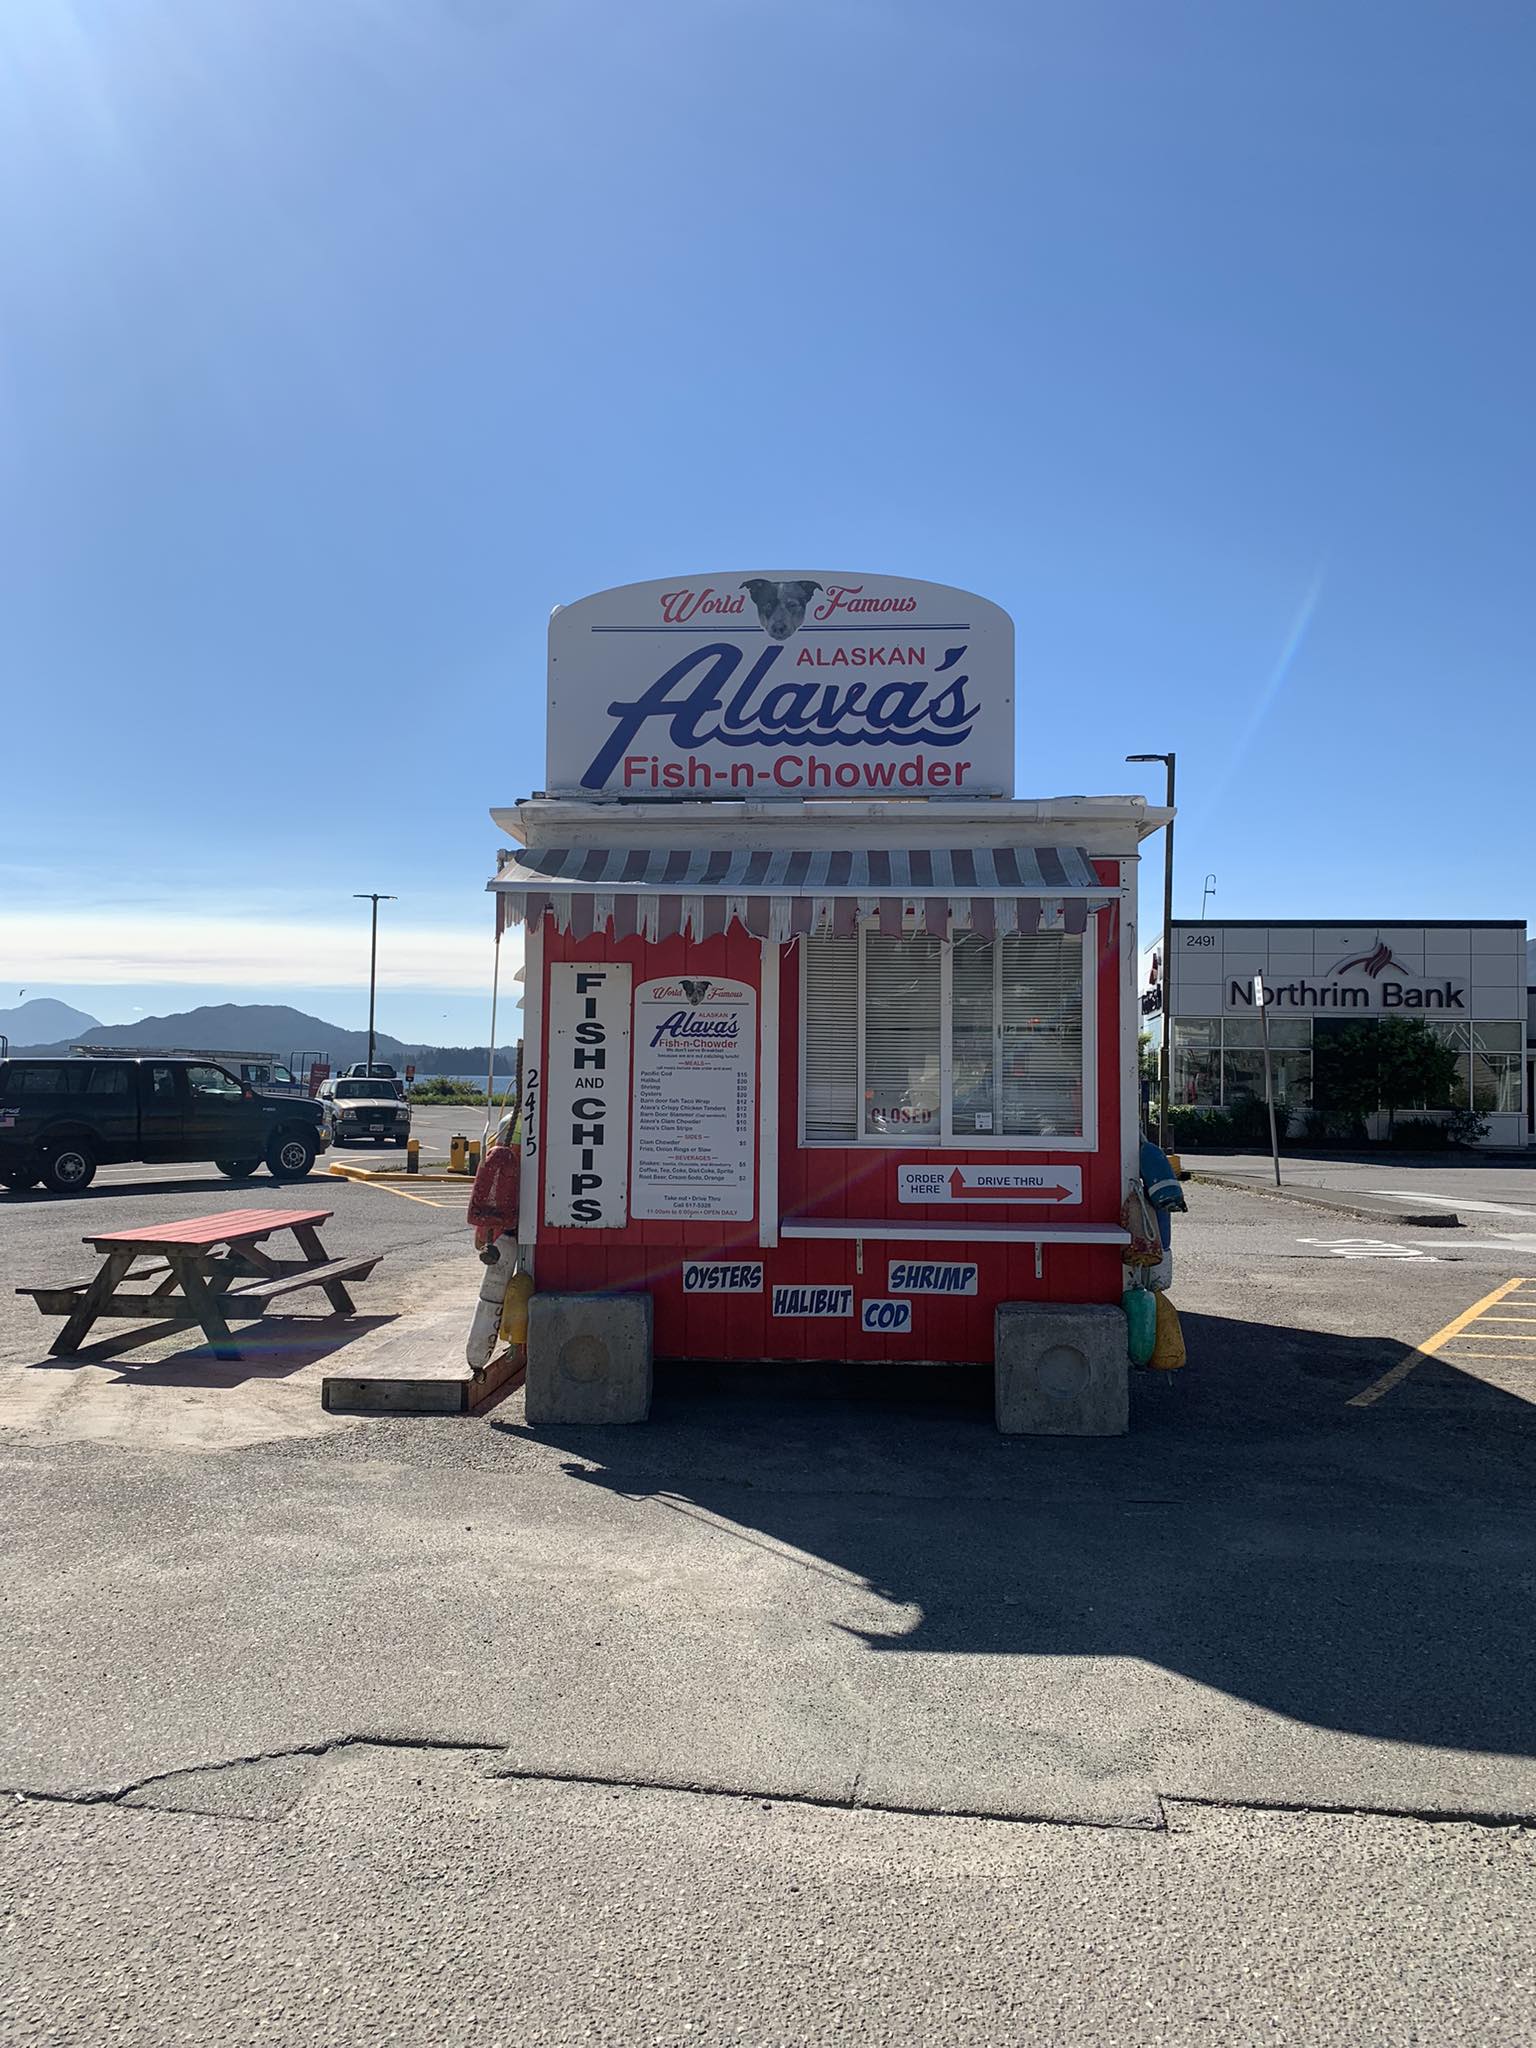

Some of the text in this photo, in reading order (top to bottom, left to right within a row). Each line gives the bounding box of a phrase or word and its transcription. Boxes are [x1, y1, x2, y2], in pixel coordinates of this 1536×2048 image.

[659, 585, 916, 623] World Famous
[796, 647, 925, 666] ALASKAN
[579, 642, 981, 789] Alava's
[623, 755, 971, 788] Fish-n-Chowder
[1186, 936, 1215, 947] 2491
[653, 987, 742, 1000] World Famous
[1231, 981, 1369, 1007] Northrim
[1383, 982, 1465, 1008] Bank
[649, 1011, 740, 1047] Alava's
[659, 1039, 738, 1048] Fish-n-Chowder
[570, 973, 606, 1221] FISH AND CHIPS
[524, 1068, 539, 1157] 2475
[871, 1107, 932, 1124] CLOSED
[906, 1174, 1044, 1186] ORDER DRIVE THRU
[911, 1184, 941, 1194] HERE
[684, 1265, 762, 1290] OYSTERS
[890, 1264, 976, 1291] SHRIMP
[774, 1289, 851, 1314] HALIBUT
[864, 1304, 908, 1328] COD
